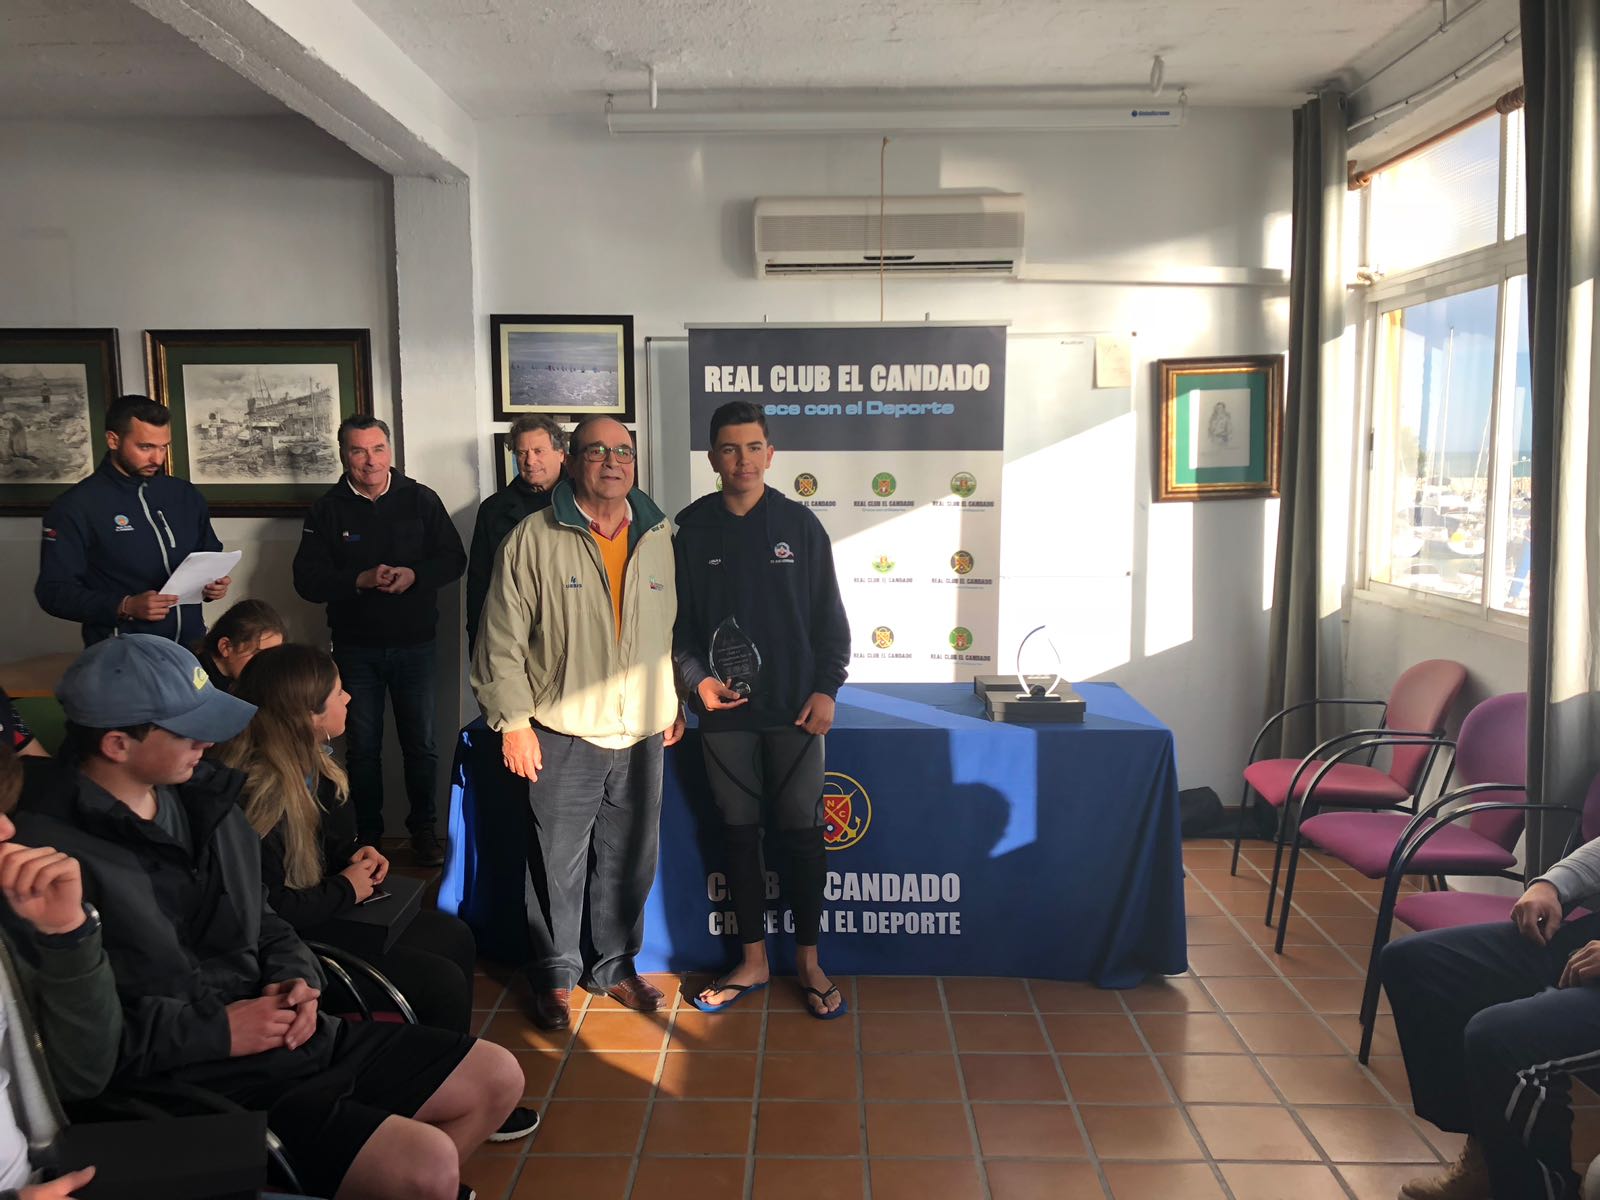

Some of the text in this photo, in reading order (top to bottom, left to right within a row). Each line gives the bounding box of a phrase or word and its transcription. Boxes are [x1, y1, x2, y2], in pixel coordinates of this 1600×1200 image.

[704, 363, 991, 393] REAL CLUB EL CANDADO
[763, 401, 954, 418] ece con el Deporte
[839, 810, 846, 818] C
[707, 871, 961, 903] CB CANDADO
[708, 909, 961, 936] CRE CN EL DEPORTE
